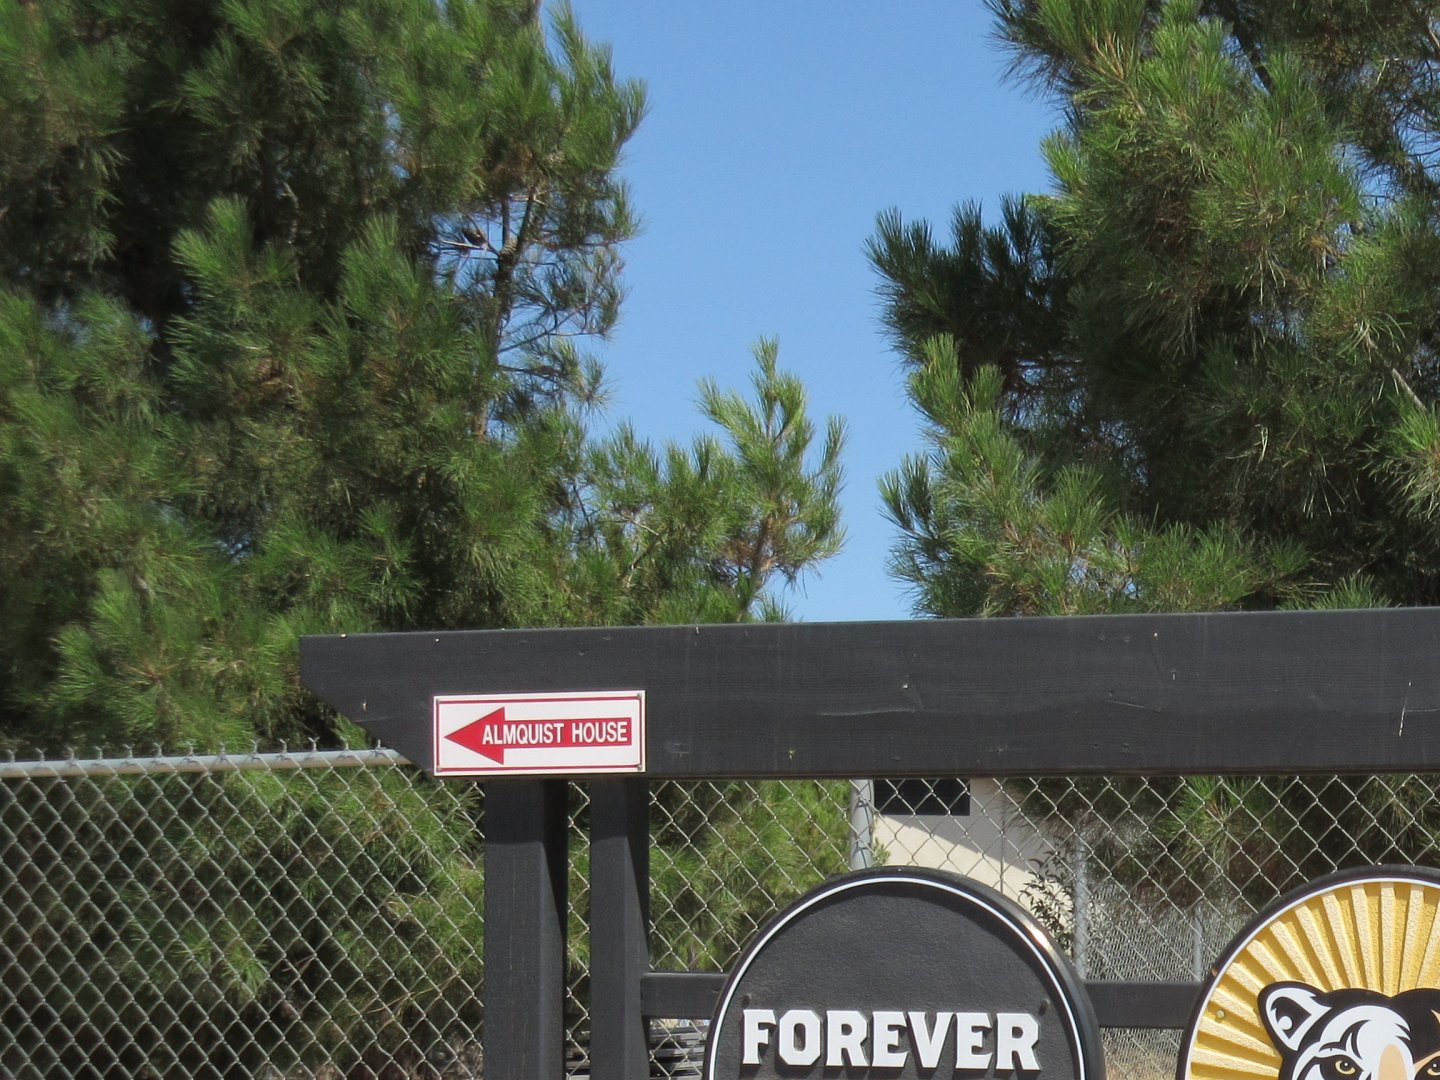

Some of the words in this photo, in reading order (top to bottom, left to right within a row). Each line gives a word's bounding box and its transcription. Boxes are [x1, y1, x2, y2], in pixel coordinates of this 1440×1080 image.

[482, 723, 564, 745] ALMQUIST
[572, 721, 628, 743] HOUSE
[742, 1009, 1040, 1070] FOREVER
